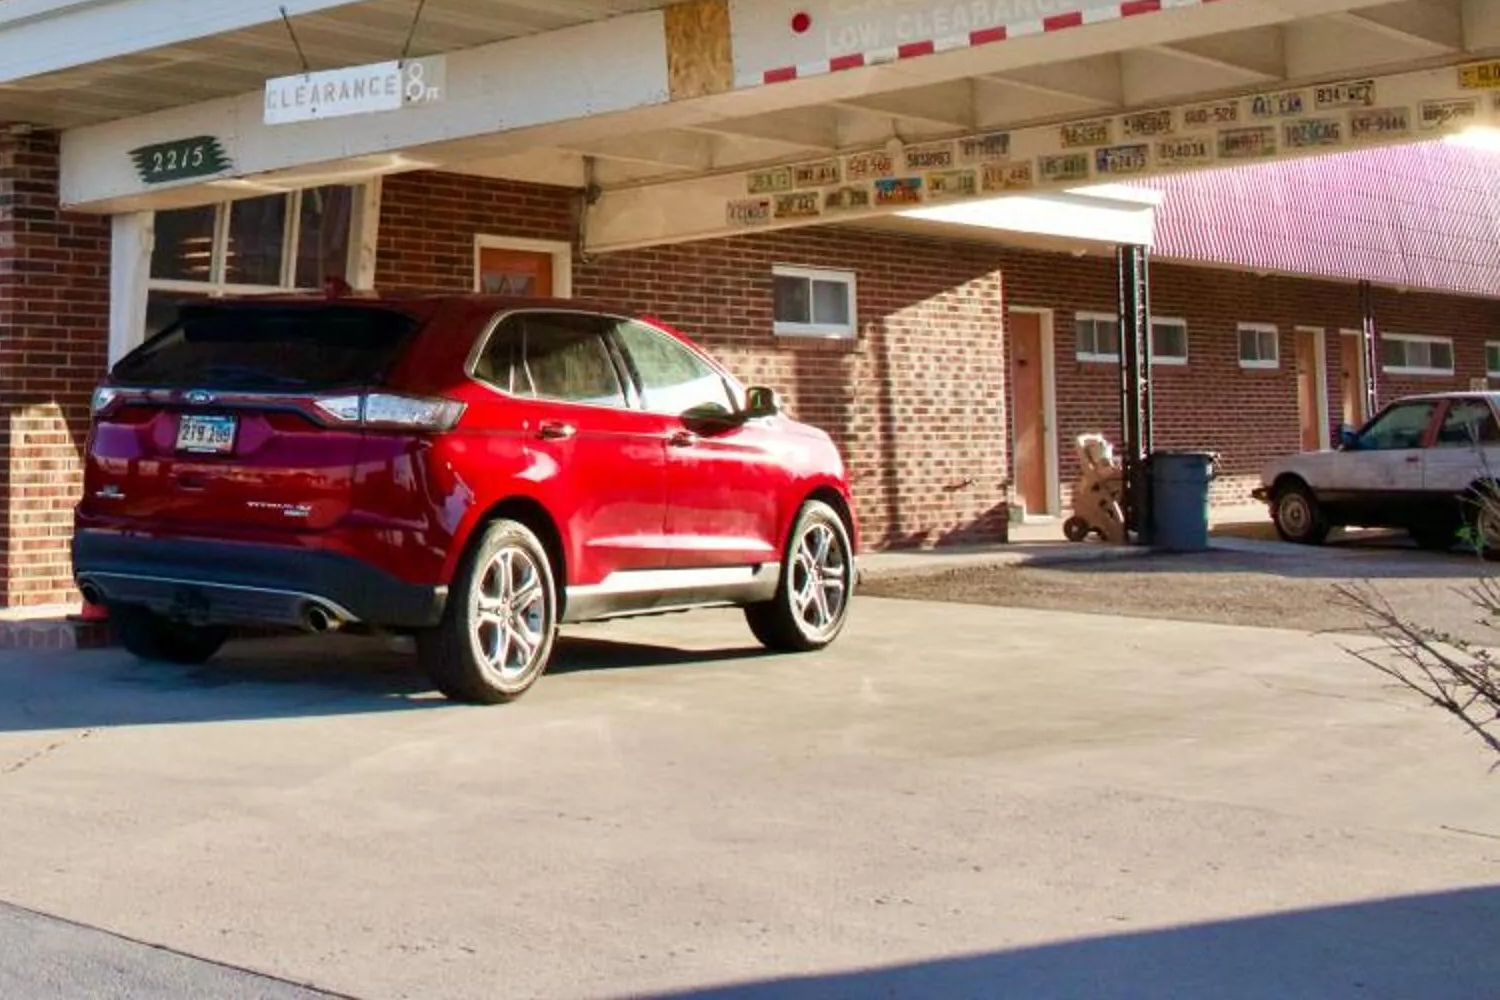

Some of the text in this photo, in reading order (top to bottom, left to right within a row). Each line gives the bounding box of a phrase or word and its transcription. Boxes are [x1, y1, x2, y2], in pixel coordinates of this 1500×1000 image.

[825, 23, 880, 54] LOW
[266, 74, 397, 110] CLEARANCE
[406, 62, 425, 101] 8
[152, 145, 205, 173] 2215
